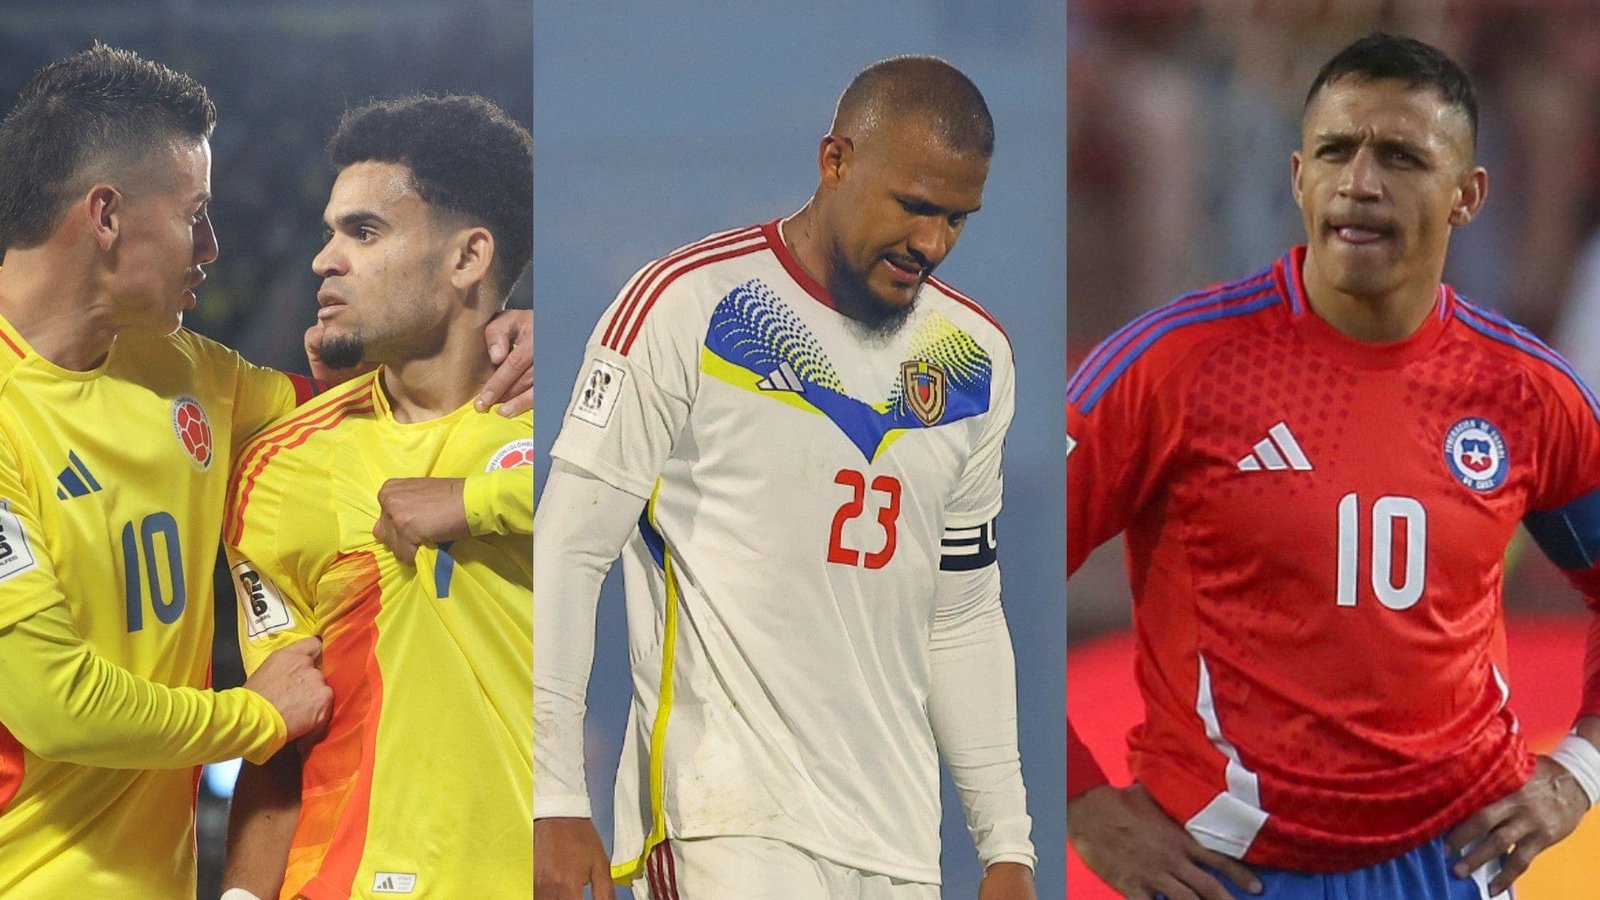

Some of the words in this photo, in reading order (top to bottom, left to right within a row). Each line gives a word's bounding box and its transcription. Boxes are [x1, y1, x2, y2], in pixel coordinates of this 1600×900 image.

[122, 511, 187, 634] 10
[827, 468, 902, 569] 23
[1336, 492, 1427, 610] 10
